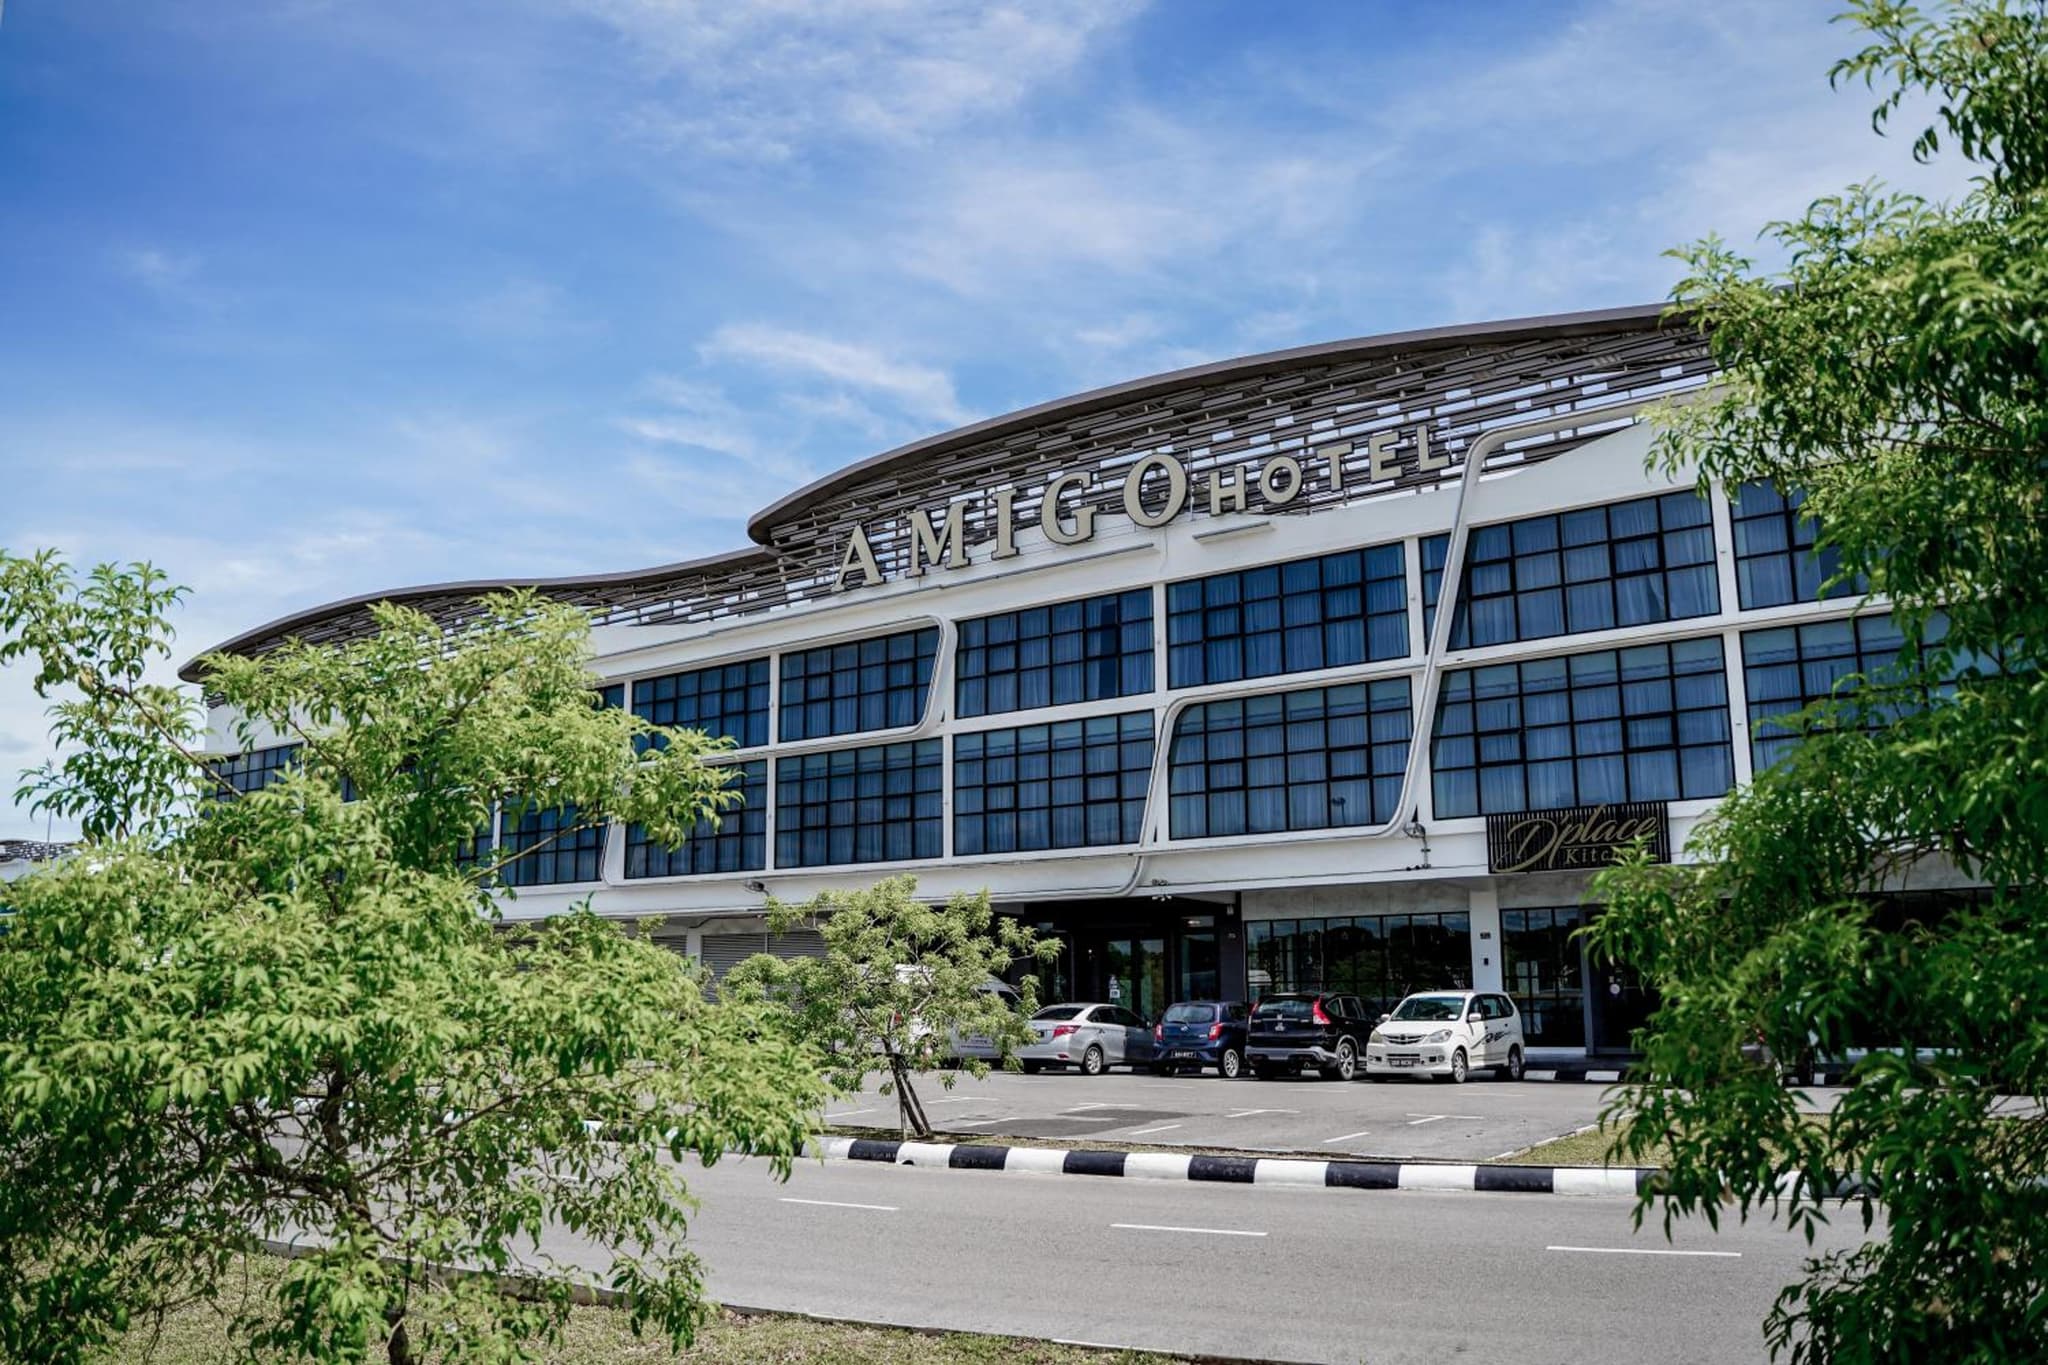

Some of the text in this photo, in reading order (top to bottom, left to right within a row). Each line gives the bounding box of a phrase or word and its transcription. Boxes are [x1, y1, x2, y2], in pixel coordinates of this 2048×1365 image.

[832, 425, 1450, 592] AMIGO HOTEL
[1565, 847, 1631, 864] Kitc
